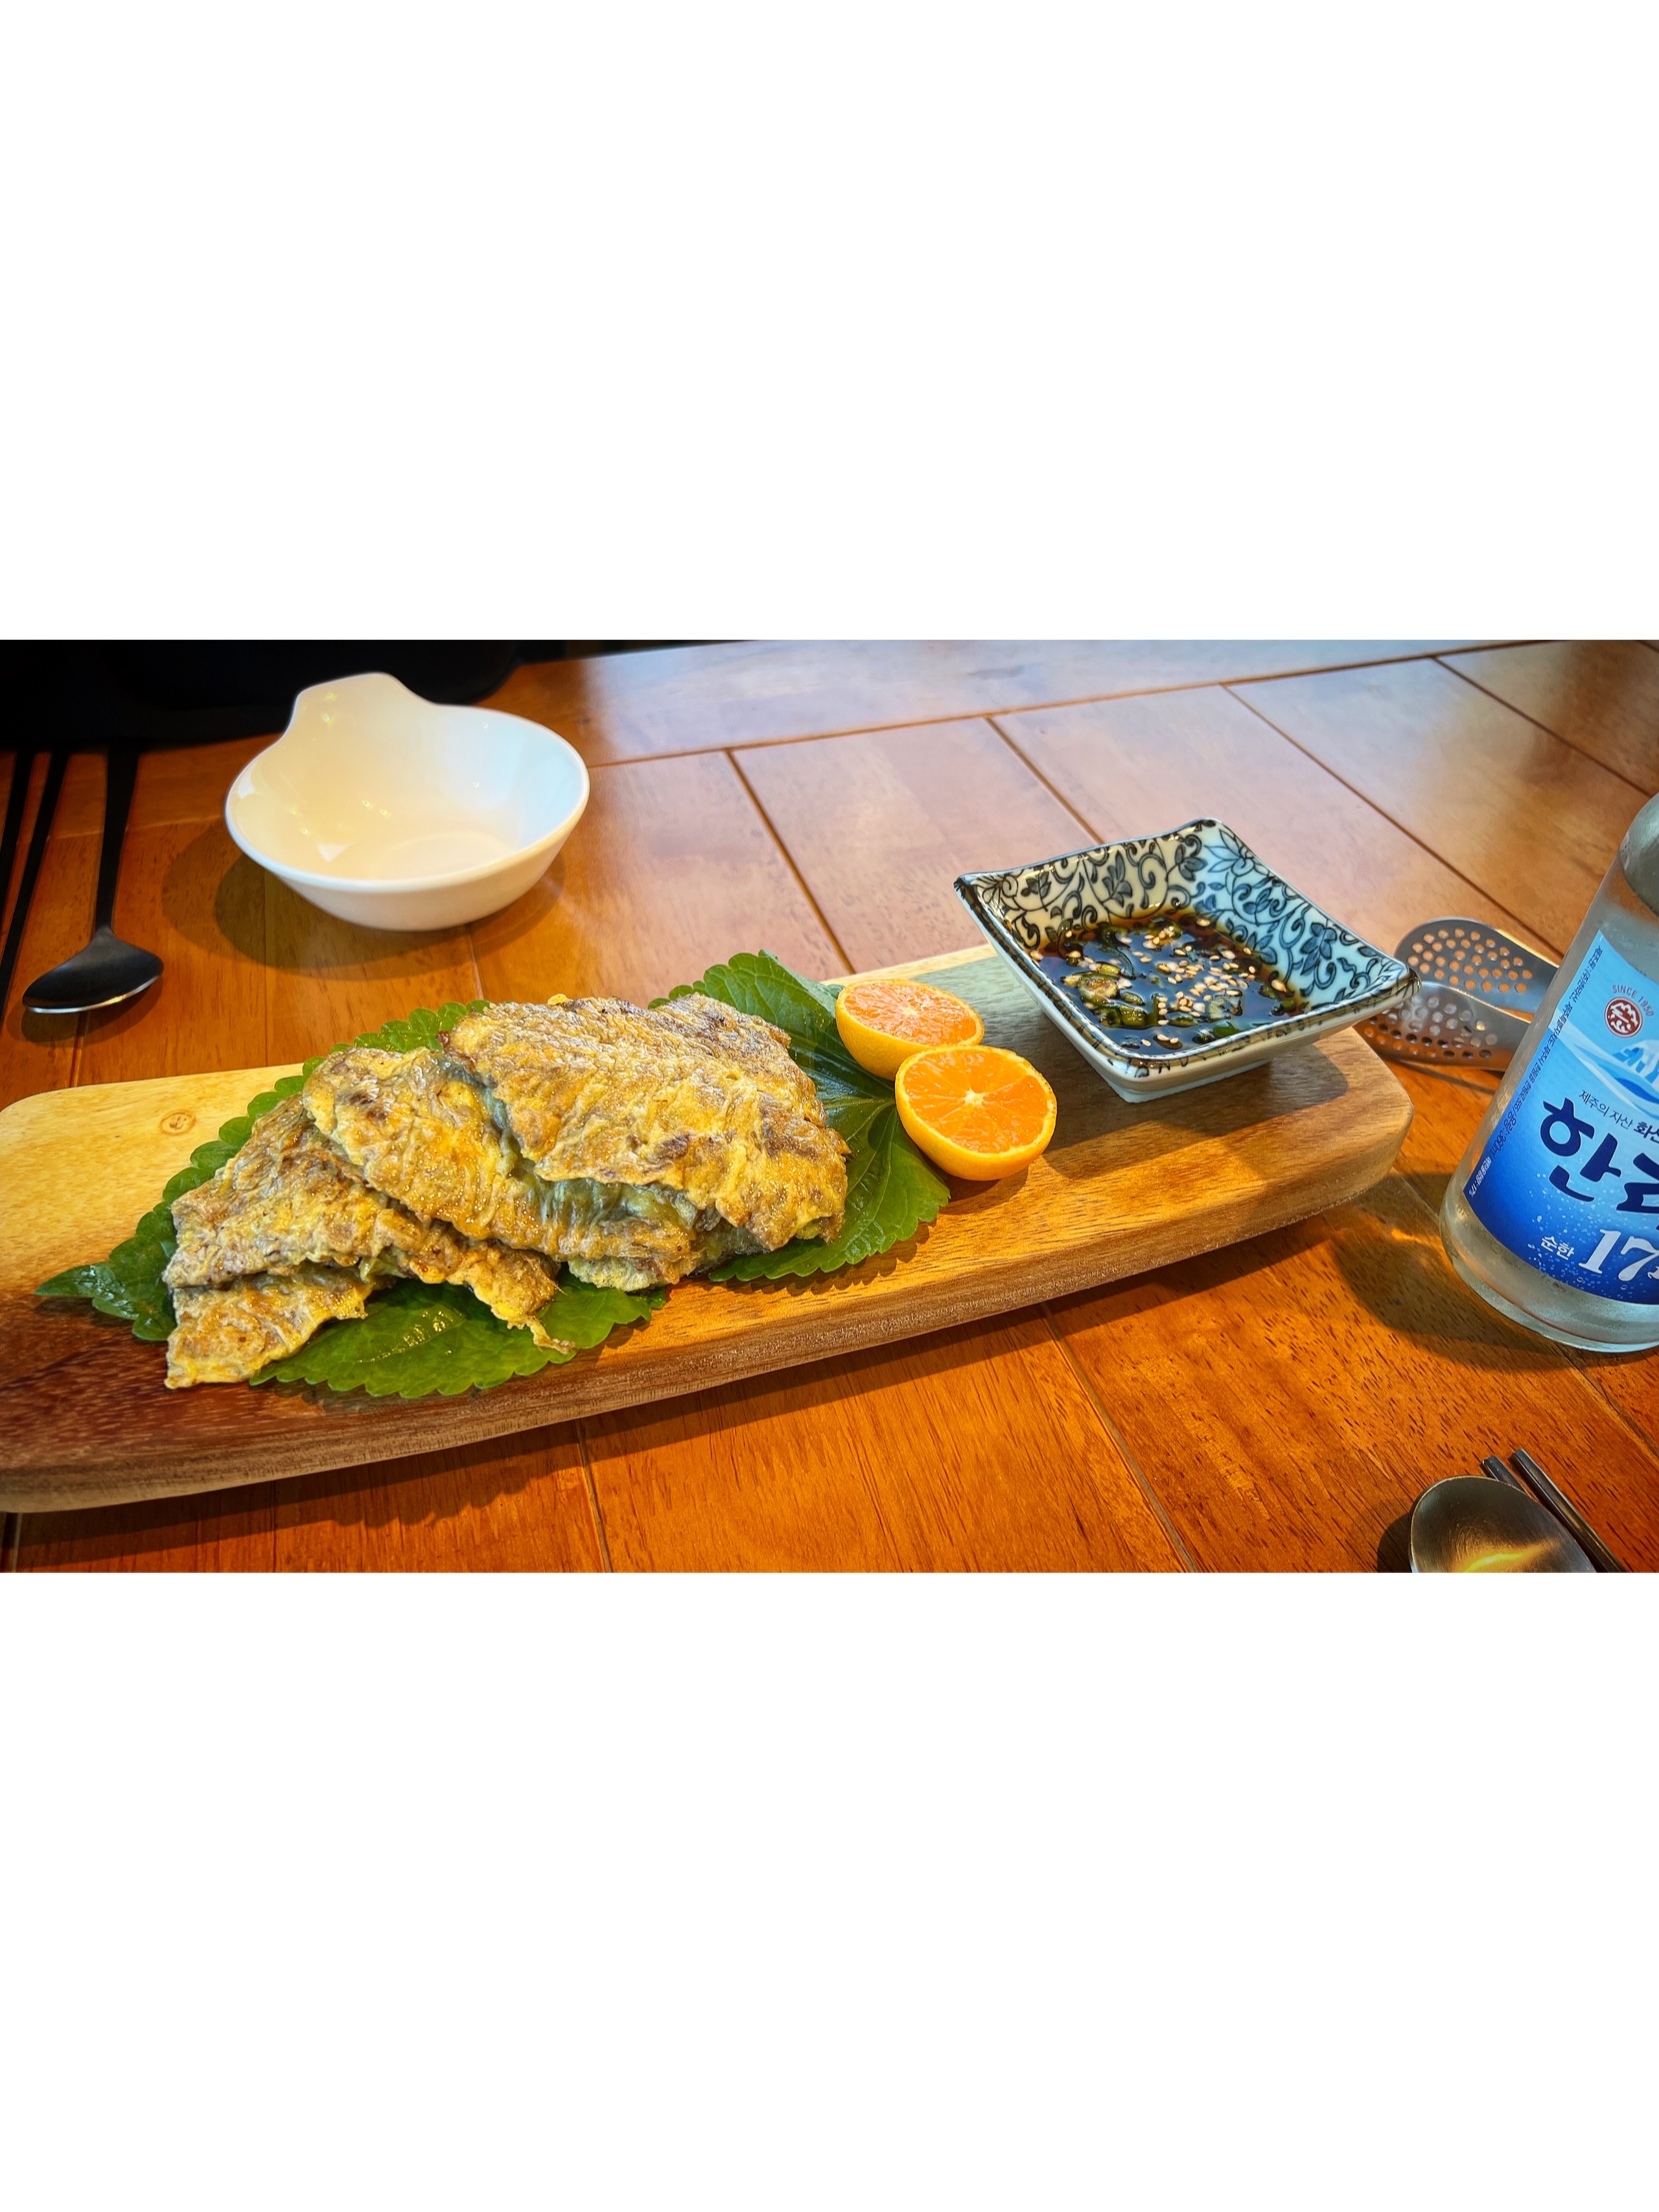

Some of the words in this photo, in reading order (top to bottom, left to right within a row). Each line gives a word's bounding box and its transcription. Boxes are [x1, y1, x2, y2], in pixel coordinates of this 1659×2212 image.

[1612, 984, 1638, 999] SINCE
[1638, 996, 1654, 1017] 1950
[1538, 1044, 1551, 1067] 제주시
[1579, 1090, 1610, 1117] 제주의
[1609, 1110, 1633, 1130] 자산
[1541, 1236, 1575, 1261] 순한
